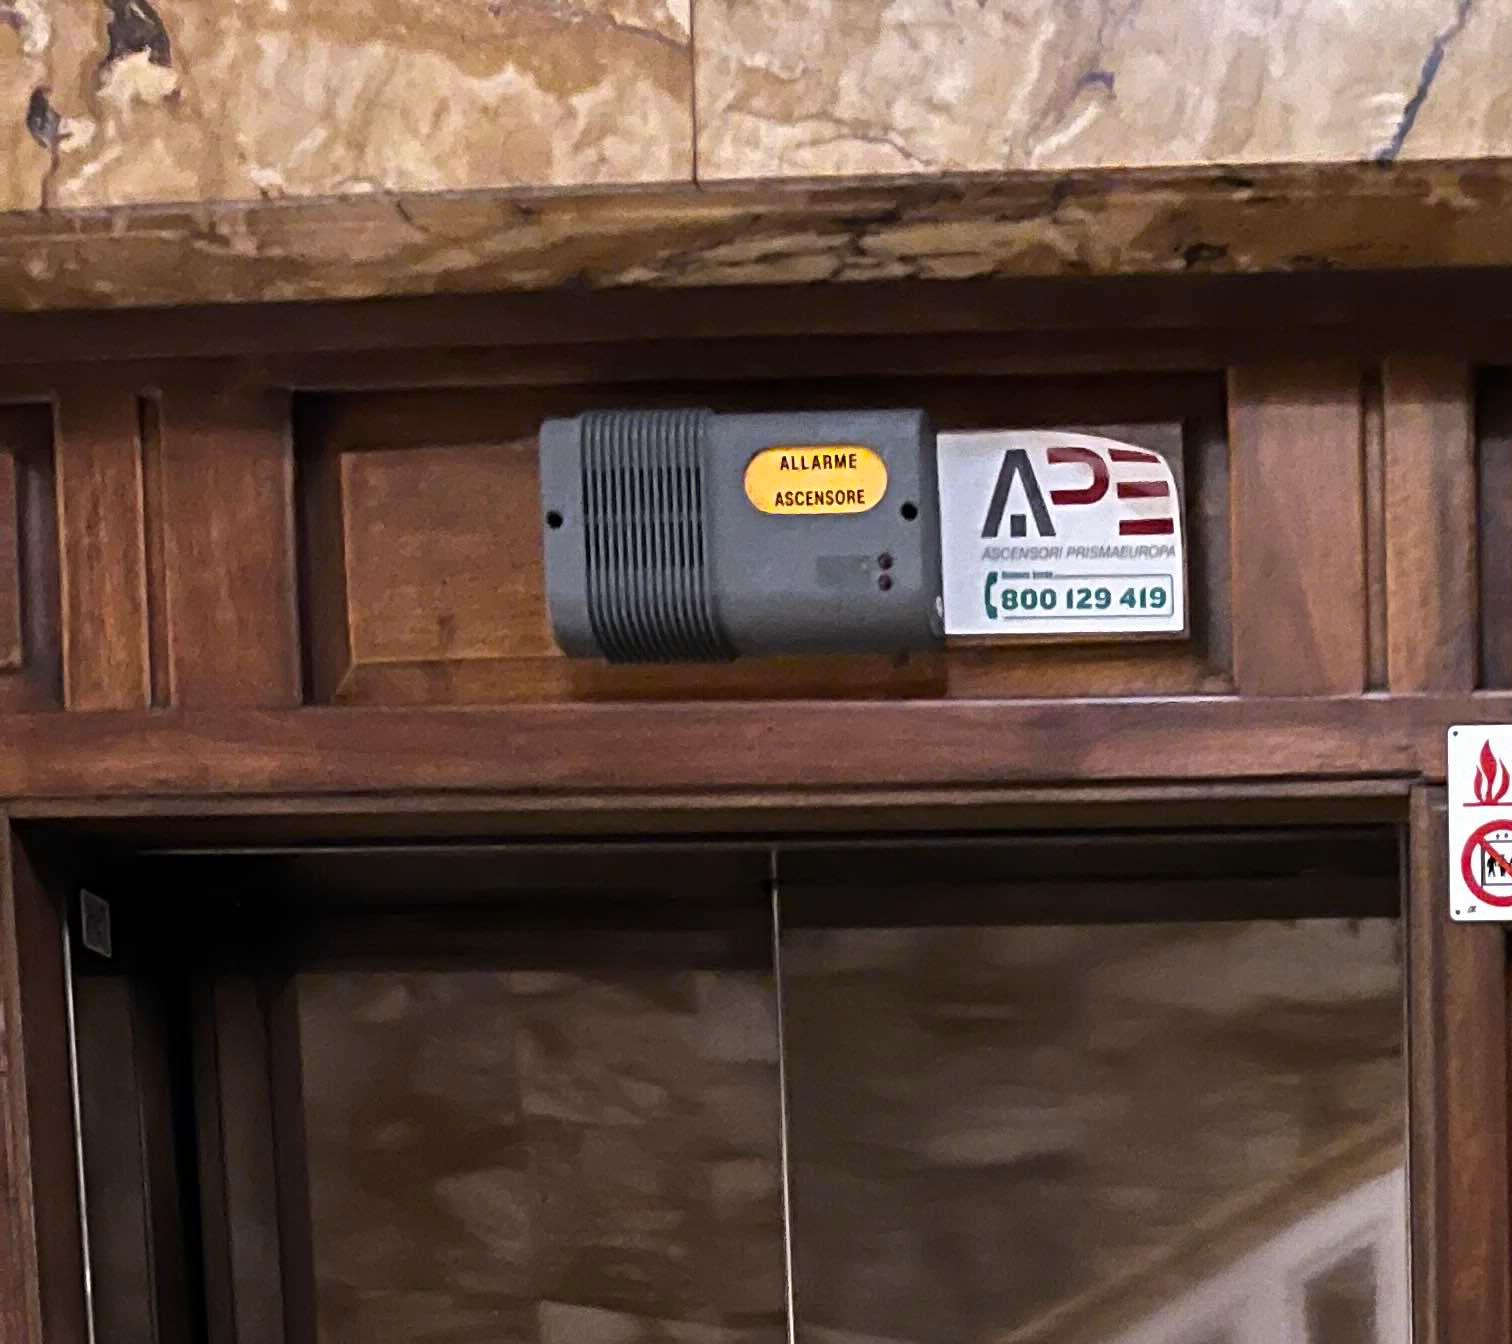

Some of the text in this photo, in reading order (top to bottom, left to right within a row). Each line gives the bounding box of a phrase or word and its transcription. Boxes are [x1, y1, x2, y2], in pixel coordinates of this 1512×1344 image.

[780, 453, 858, 471] ALLARME
[774, 488, 866, 507] ASCENSORE
[980, 446, 1175, 539] APE
[980, 543, 1176, 561] ASCENSORI PRISMAEUROPA
[1001, 585, 1168, 611] 800 129 419
